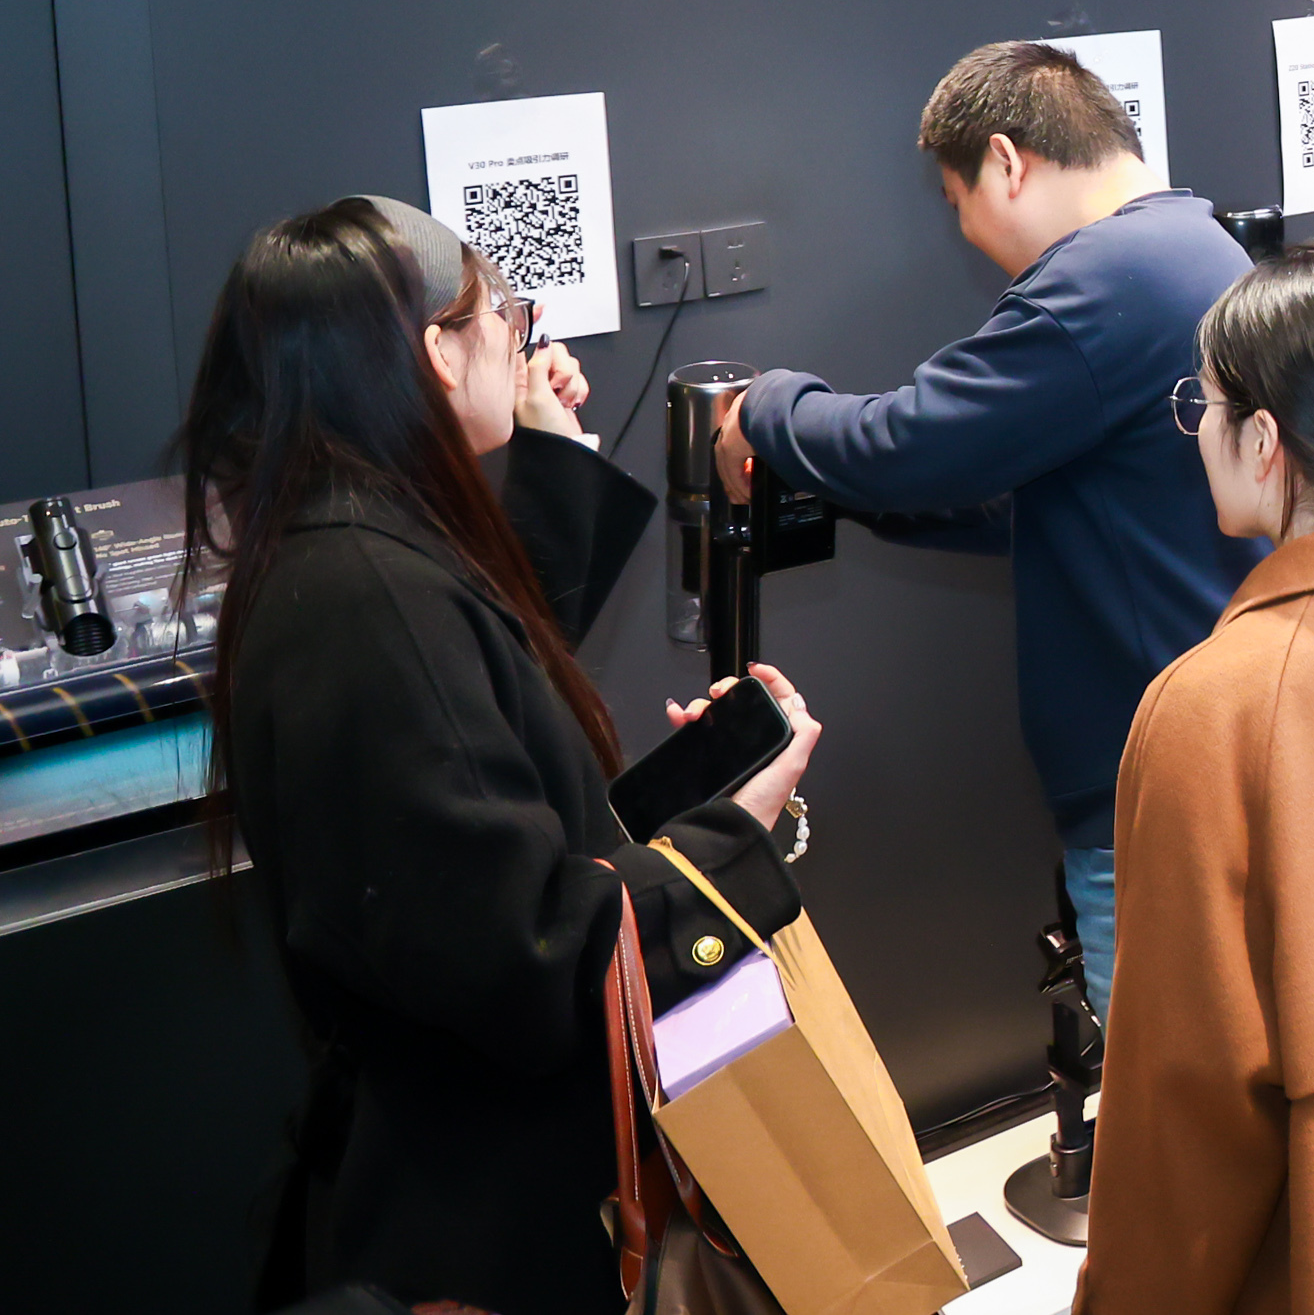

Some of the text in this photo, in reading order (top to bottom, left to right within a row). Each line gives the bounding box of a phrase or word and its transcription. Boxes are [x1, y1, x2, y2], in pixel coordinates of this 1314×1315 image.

[468, 161, 486, 170] V30
[488, 159, 504, 168] Pro
[84, 499, 121, 512] Brush
